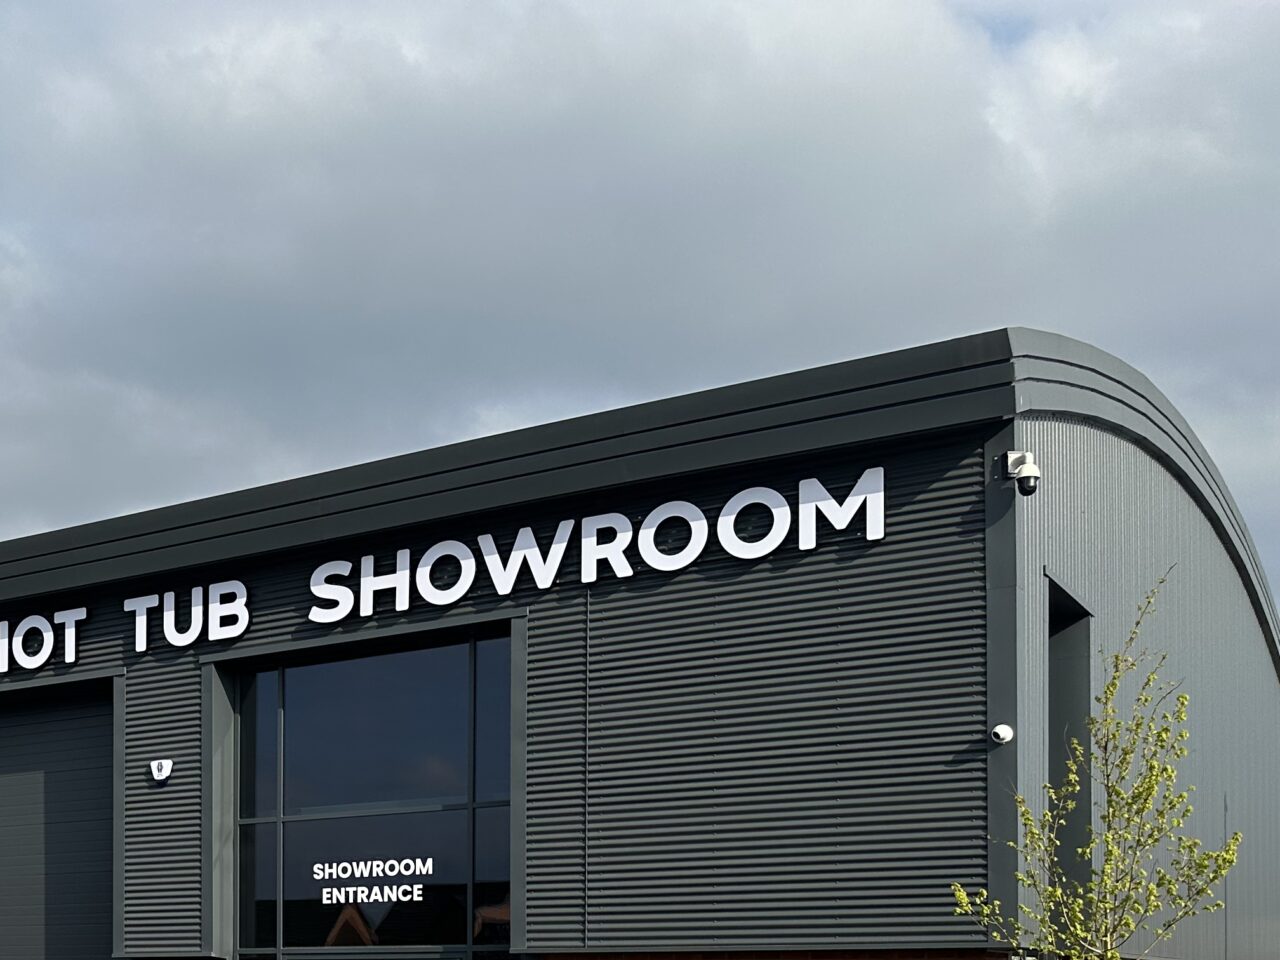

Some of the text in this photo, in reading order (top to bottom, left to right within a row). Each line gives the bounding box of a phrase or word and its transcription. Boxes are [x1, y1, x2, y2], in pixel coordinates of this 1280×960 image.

[123, 580, 250, 653] TUB
[308, 466, 886, 624] SHOWROOM
[312, 857, 433, 880] SHOWROOM
[322, 884, 423, 905] ENTRANCE
